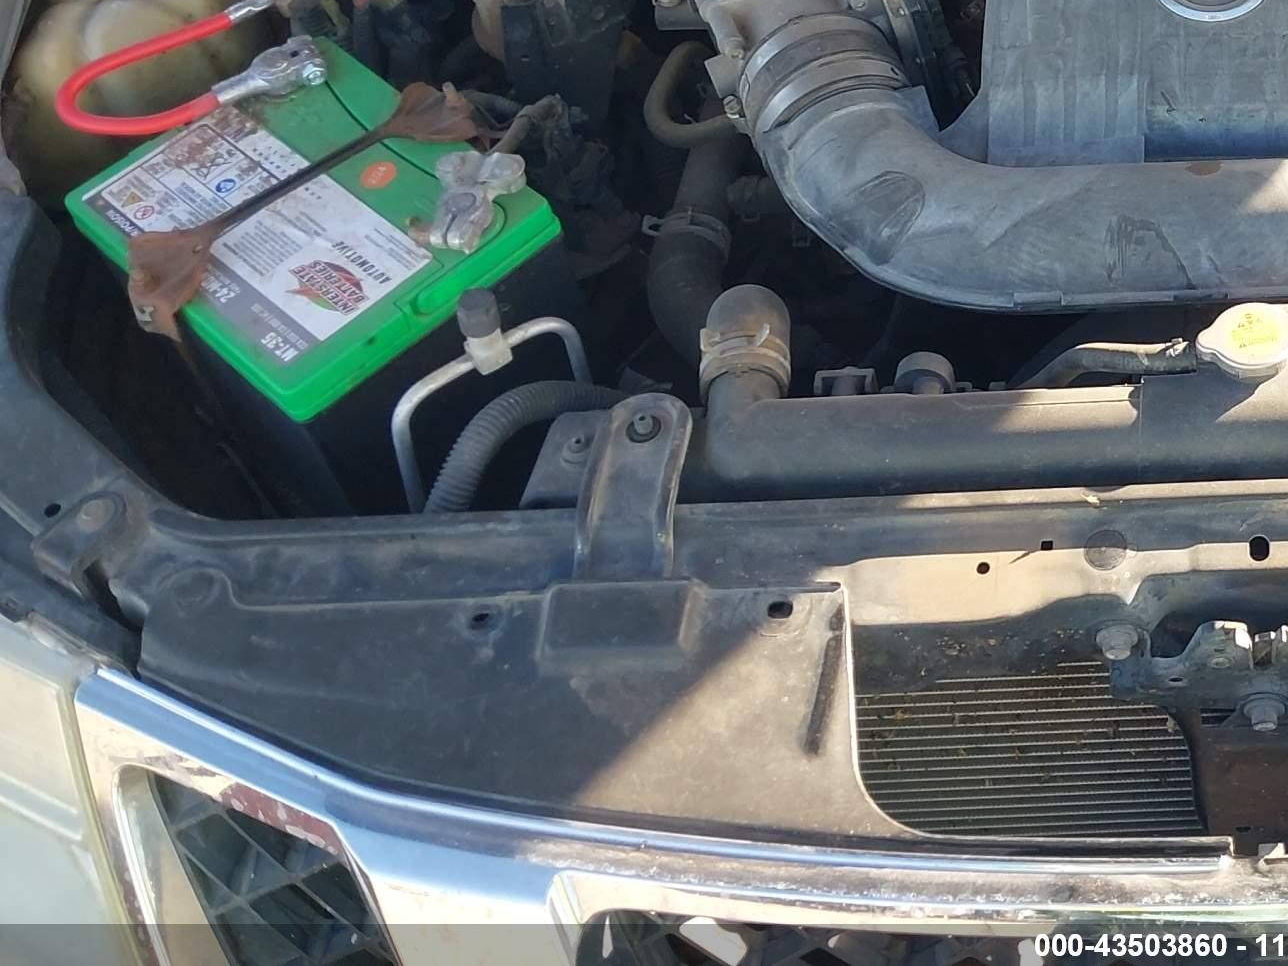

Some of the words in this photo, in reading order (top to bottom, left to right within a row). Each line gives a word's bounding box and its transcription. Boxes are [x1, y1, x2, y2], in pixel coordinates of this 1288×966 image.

[310, 261, 365, 304] BATTERIES
[331, 241, 392, 284] AUTOMOTIVE
[293, 265, 355, 314] INTERSTATE
[260, 331, 299, 362] MT-35
